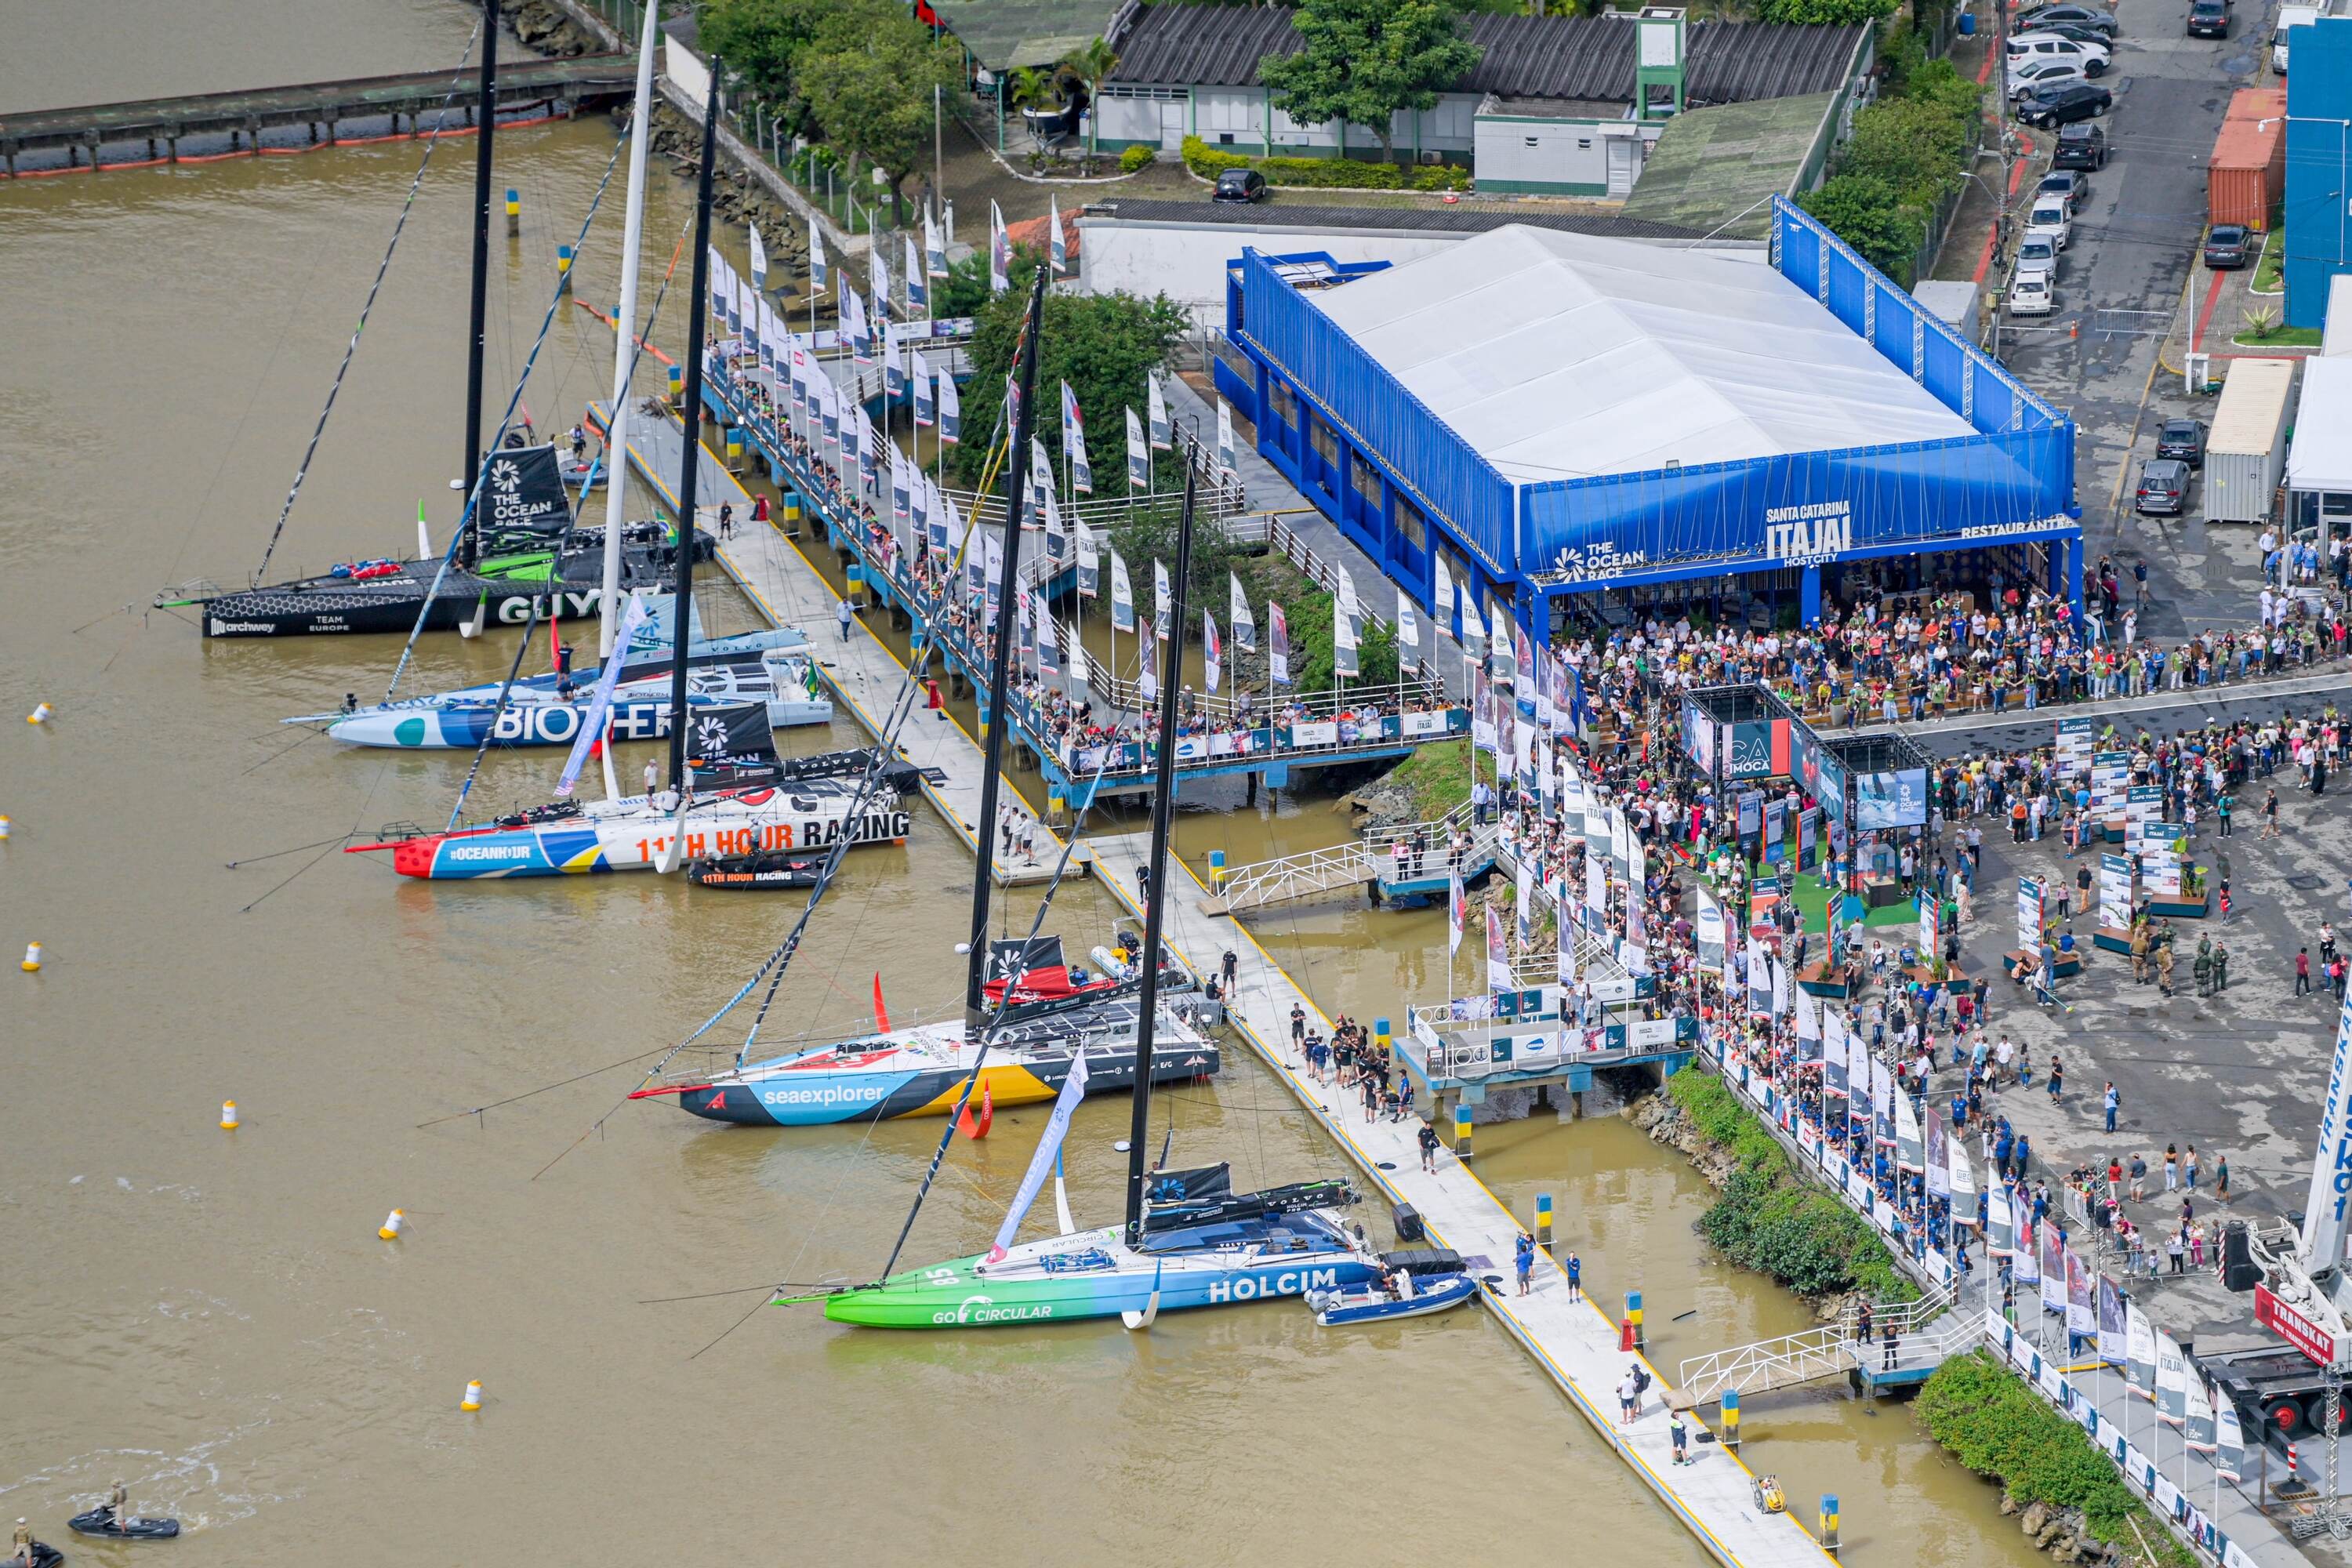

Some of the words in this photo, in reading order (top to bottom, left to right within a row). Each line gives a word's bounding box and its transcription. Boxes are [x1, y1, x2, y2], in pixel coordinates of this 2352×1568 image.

[493, 493, 521, 506] THE
[494, 501, 552, 519] OCEAN
[1766, 506, 1798, 523] SANTA
[1799, 500, 1850, 518] CATARINA
[1587, 541, 1613, 556] THE
[1587, 550, 1644, 570] OCEAN
[1784, 555, 1813, 568] HOST
[1813, 553, 1838, 564] CITY
[1588, 567, 1624, 581] RACE
[315, 615, 343, 624] TEAM
[226, 622, 274, 633] archwey
[712, 643, 762, 652] VOLVO
[2062, 724, 2091, 732] ALICANTE
[799, 758, 851, 769] VOLVO
[1730, 761, 1770, 775] IMOCA
[2104, 862, 2127, 873] NEWPORT
[702, 873, 724, 884] 11TH
[727, 873, 753, 882] HOUR
[755, 872, 792, 881] RACING
[1098, 985, 1142, 998] VOLV
[764, 1085, 885, 1106] seaexplorer
[1267, 1193, 1324, 1207] VOLVO
[1052, 1234, 1104, 1248] CIRCULAR
[1209, 1267, 1337, 1303] HOLCIM
[933, 1312, 956, 1324] GO
[975, 1305, 1052, 1322] CIRCULAR
[2272, 1299, 2331, 1353] TRANSKAT
